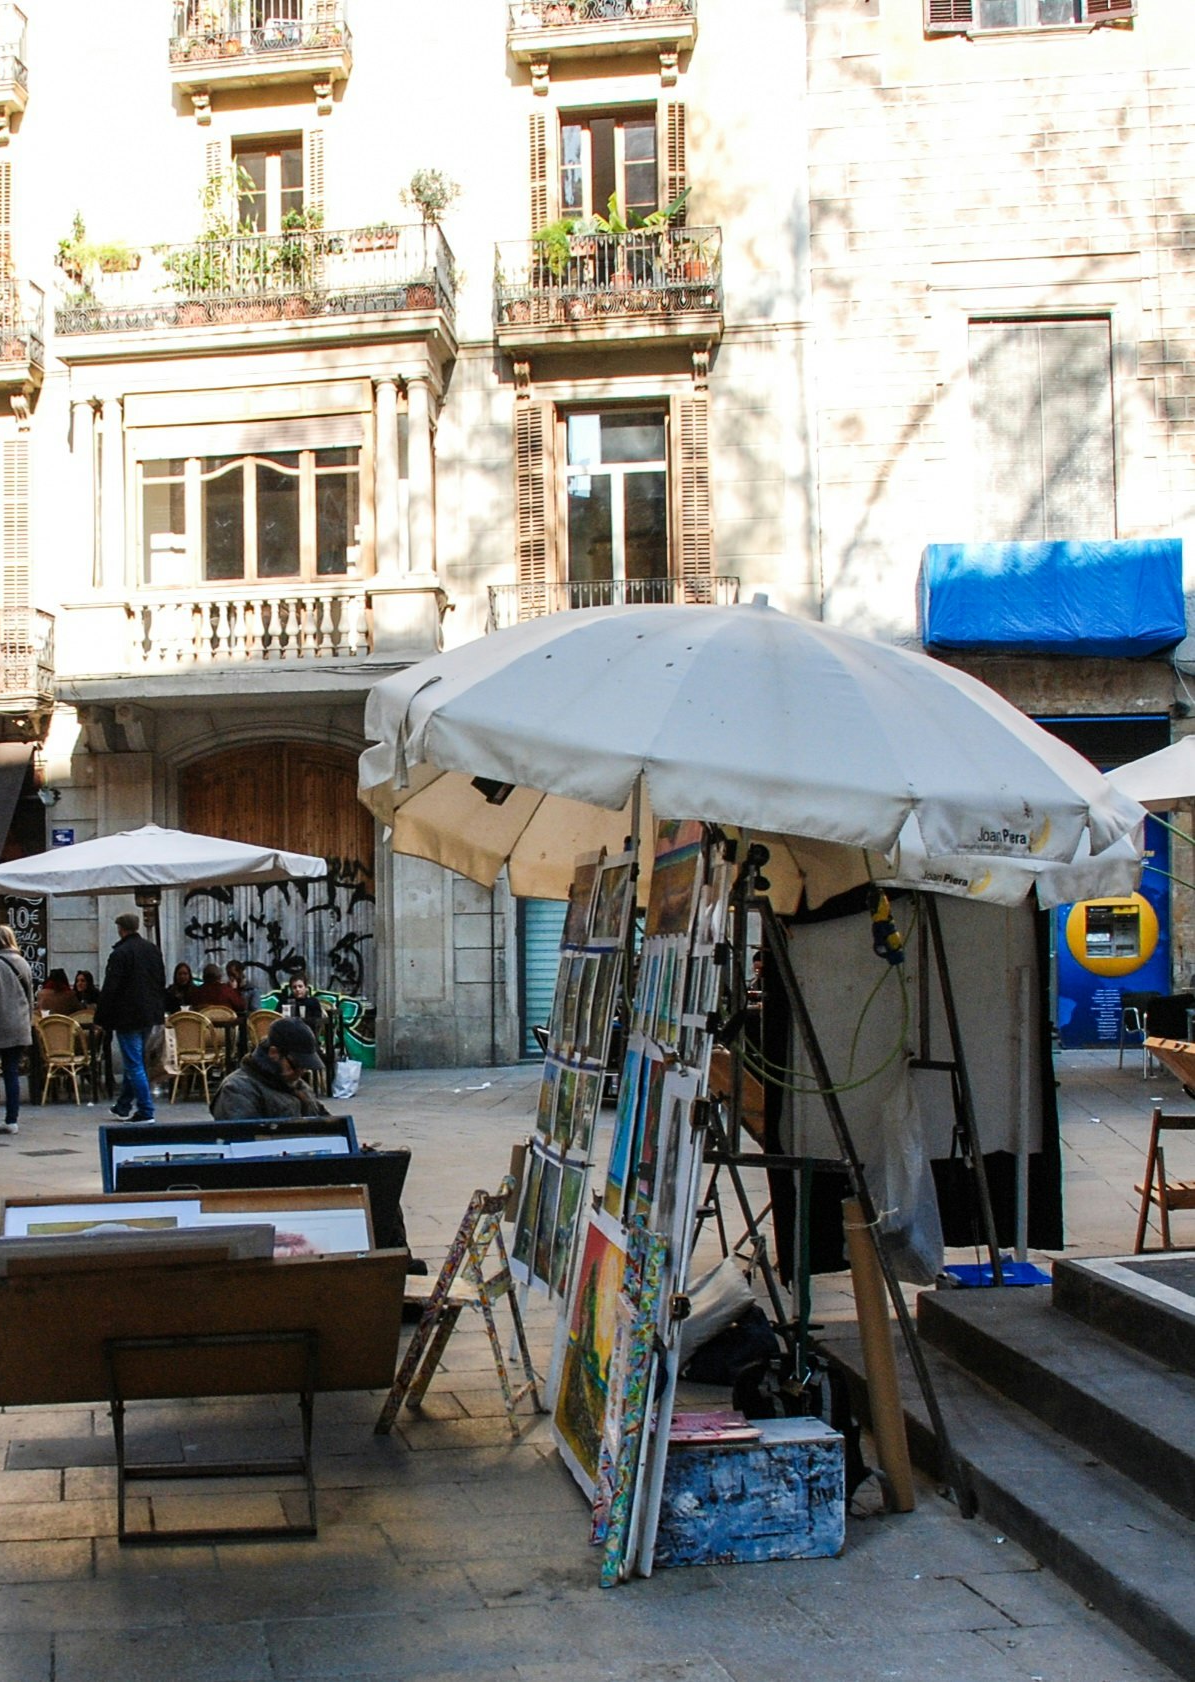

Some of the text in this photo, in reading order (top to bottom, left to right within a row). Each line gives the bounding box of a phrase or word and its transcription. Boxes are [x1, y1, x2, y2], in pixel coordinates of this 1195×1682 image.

[977, 826, 1002, 842] Joan
[921, 870, 943, 881] Joan
[7, 906, 40, 929] 10€
